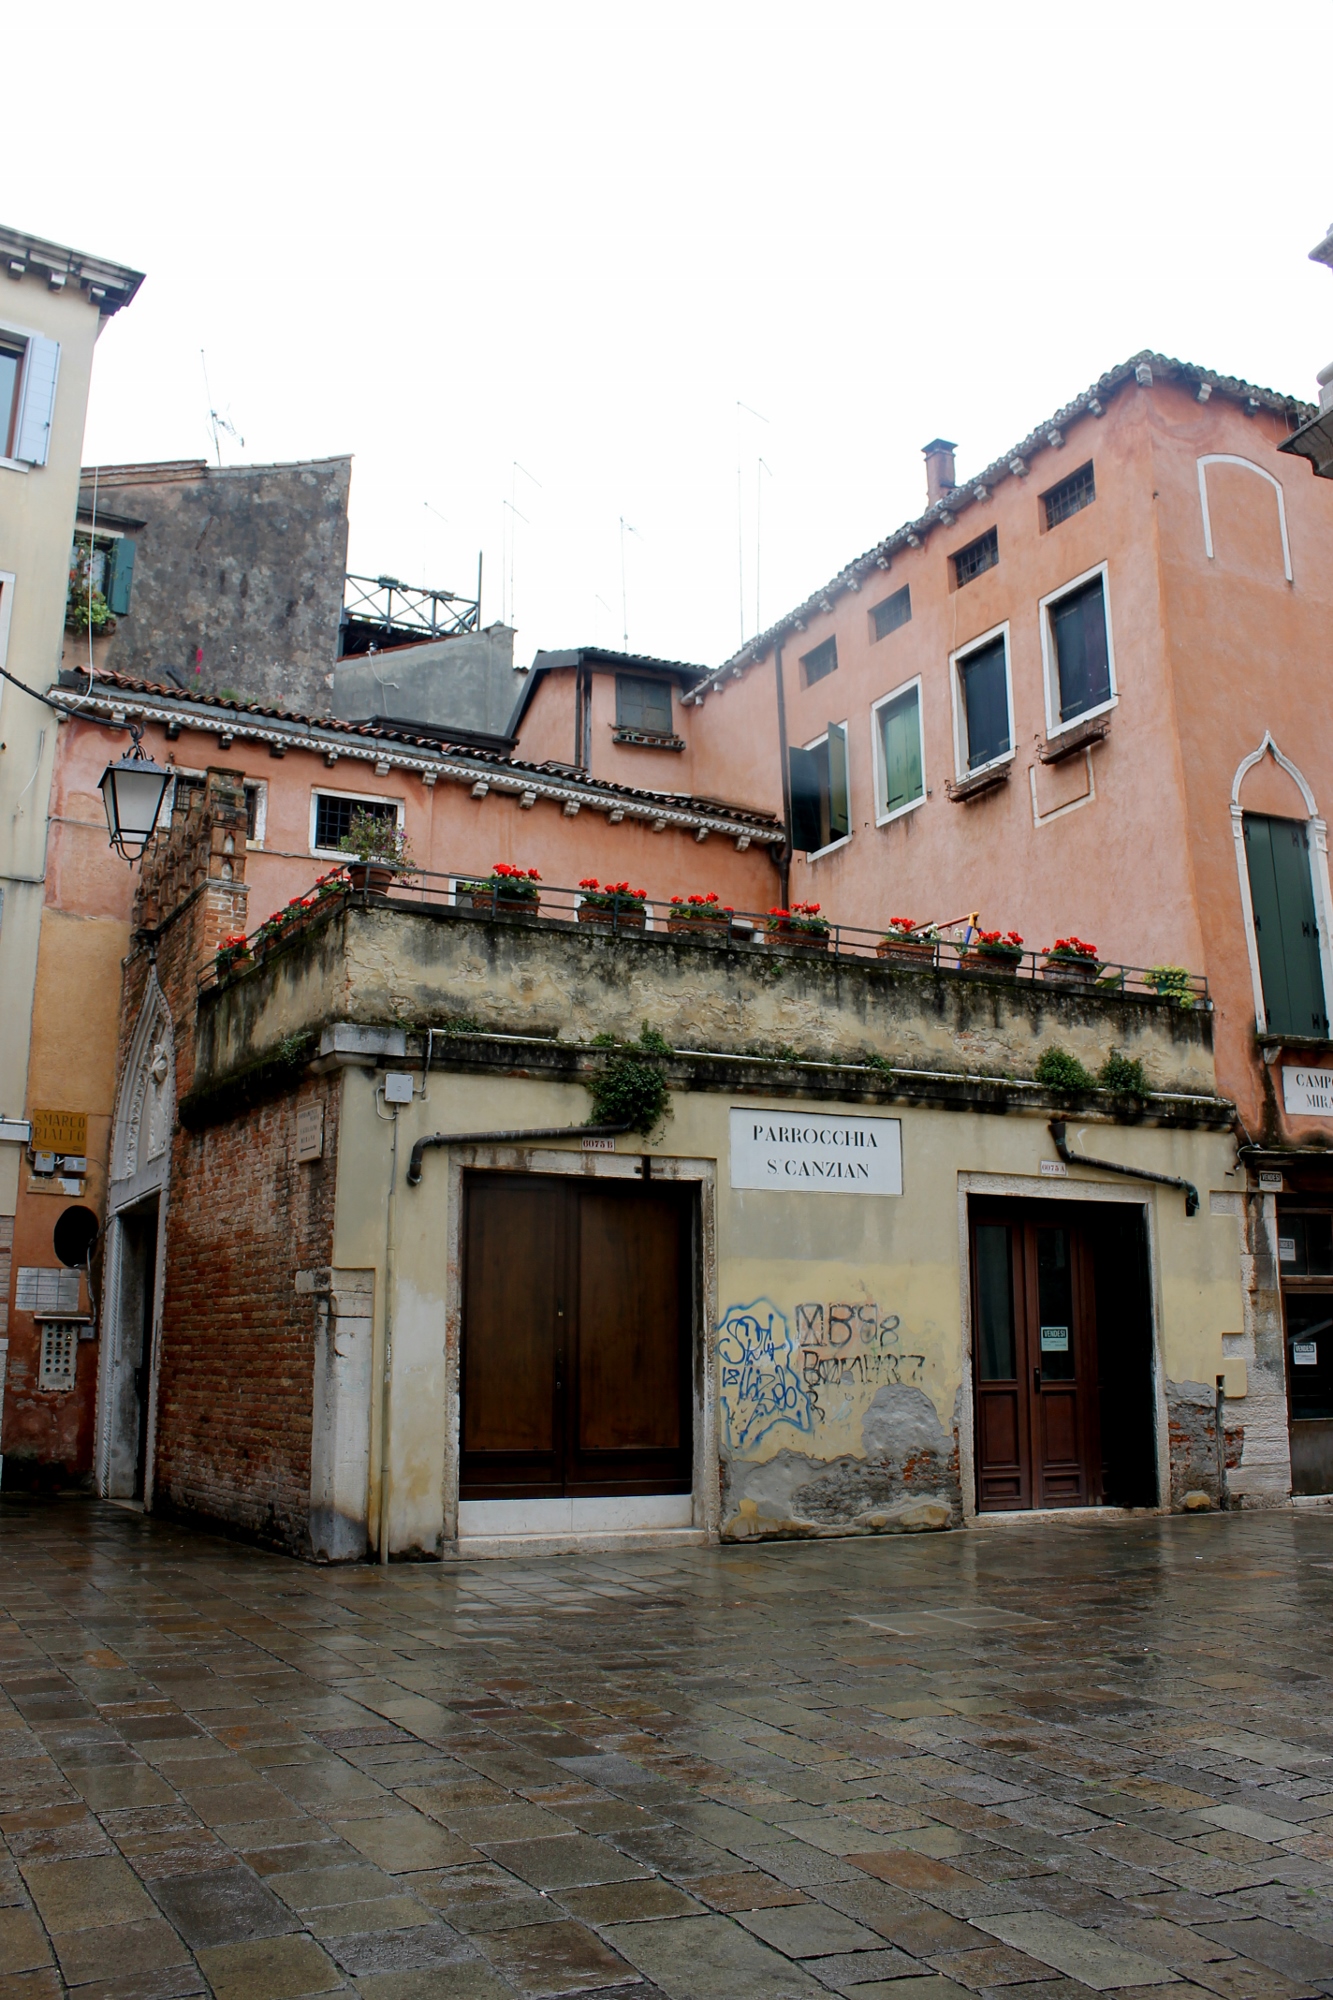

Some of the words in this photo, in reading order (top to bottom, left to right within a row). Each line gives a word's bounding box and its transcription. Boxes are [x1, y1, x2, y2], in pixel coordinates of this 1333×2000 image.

[1296, 1074, 1333, 1089] CAMP
[34, 1127, 84, 1142] RIALTO
[753, 1125, 878, 1148] PARROCCHIA
[583, 1140, 605, 1148] 6075
[784, 1160, 869, 1178] CANZIAN
[1044, 1330, 1066, 1338] VENDESI
[1296, 1344, 1314, 1352] VENDESI
